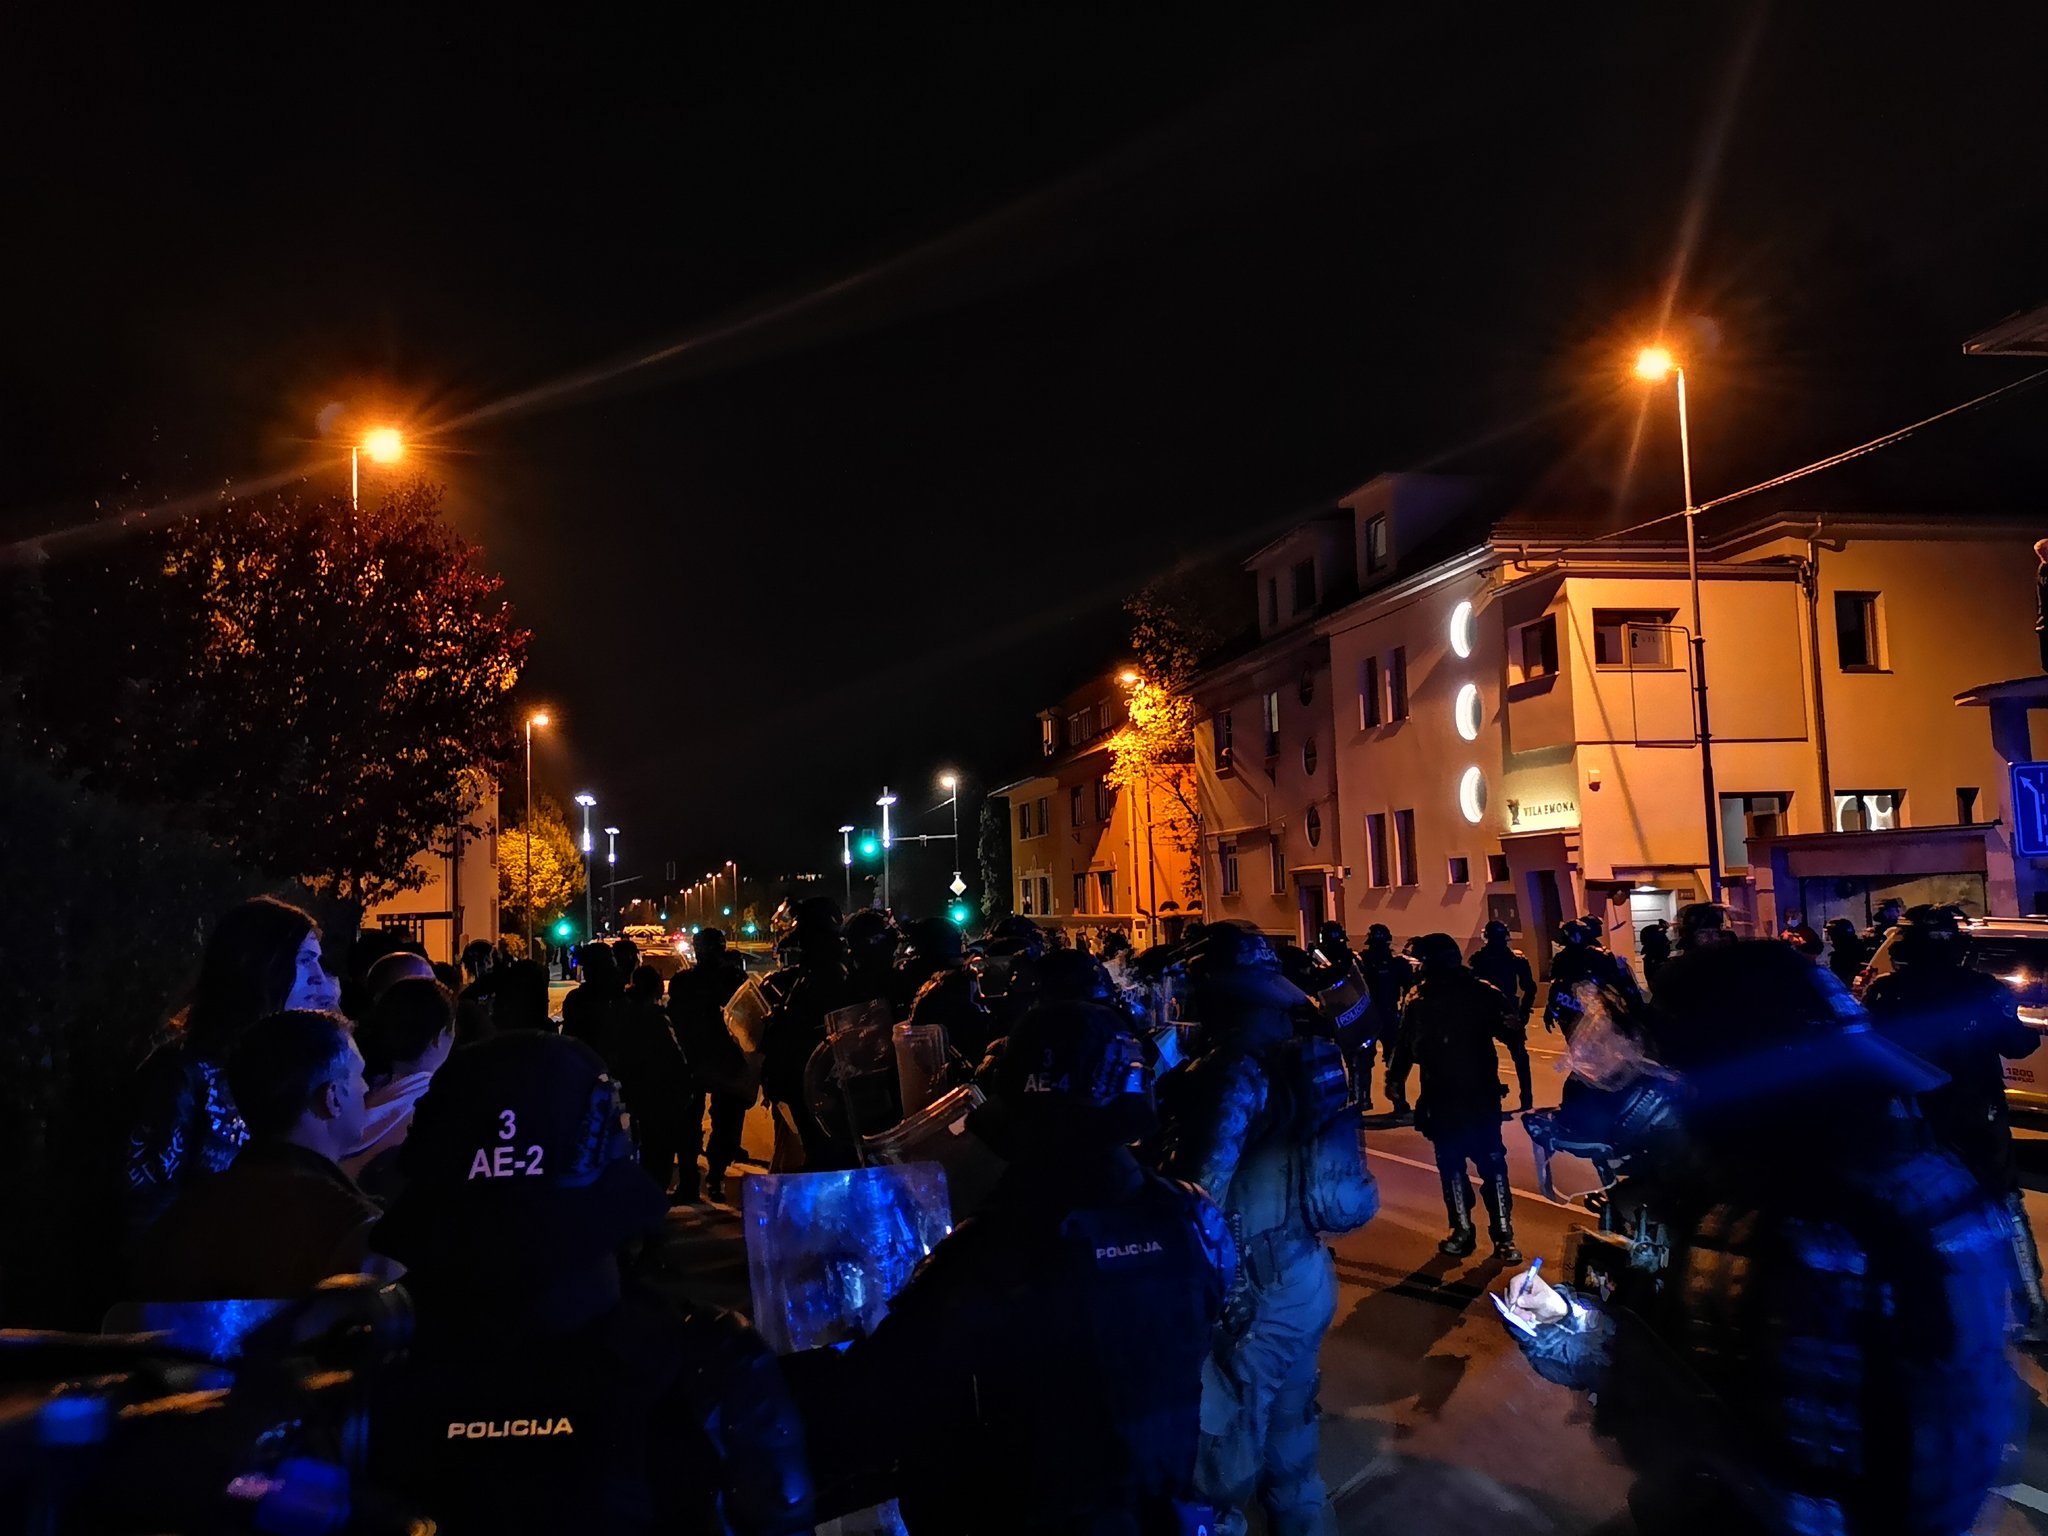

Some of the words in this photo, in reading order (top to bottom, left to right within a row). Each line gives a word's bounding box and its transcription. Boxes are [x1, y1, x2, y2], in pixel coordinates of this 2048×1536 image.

[1523, 806, 1542, 817] VILA
[1545, 801, 1575, 815] EMONA
[1024, 1072, 1070, 1093] AE-4
[498, 1109, 516, 1140] 3
[467, 1144, 544, 1181] AE-2
[1095, 1240, 1163, 1259] POLICIJA
[447, 1416, 574, 1440] POLICIJA
